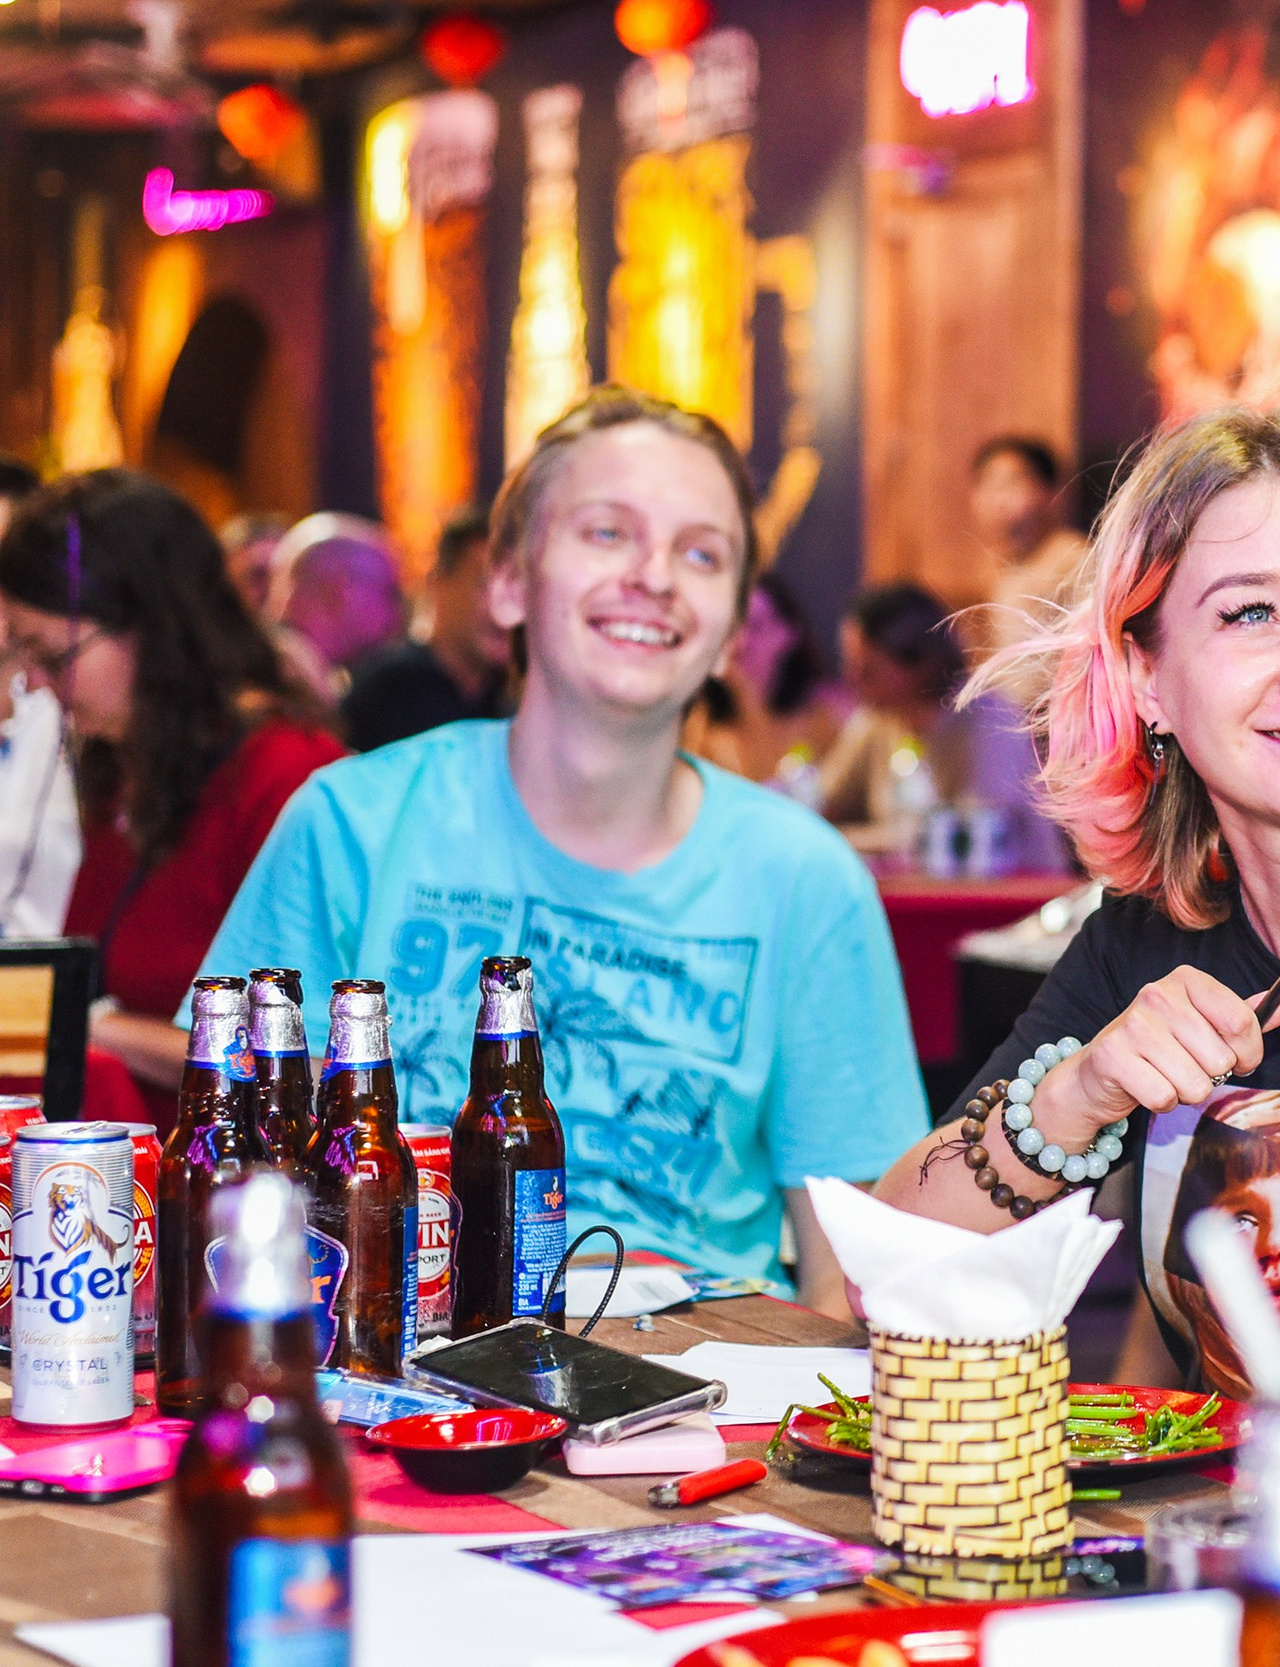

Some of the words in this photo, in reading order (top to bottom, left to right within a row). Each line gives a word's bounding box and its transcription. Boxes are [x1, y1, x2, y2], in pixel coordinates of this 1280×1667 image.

[388, 917, 503, 998] 97
[543, 1191, 564, 1210] Tiger
[13, 1250, 132, 1324] Tiger
[18, 1305, 45, 1314] SINCE
[90, 1304, 117, 1313] 1932
[19, 1328, 54, 1346] World
[32, 1358, 108, 1372] CRYSTAL
